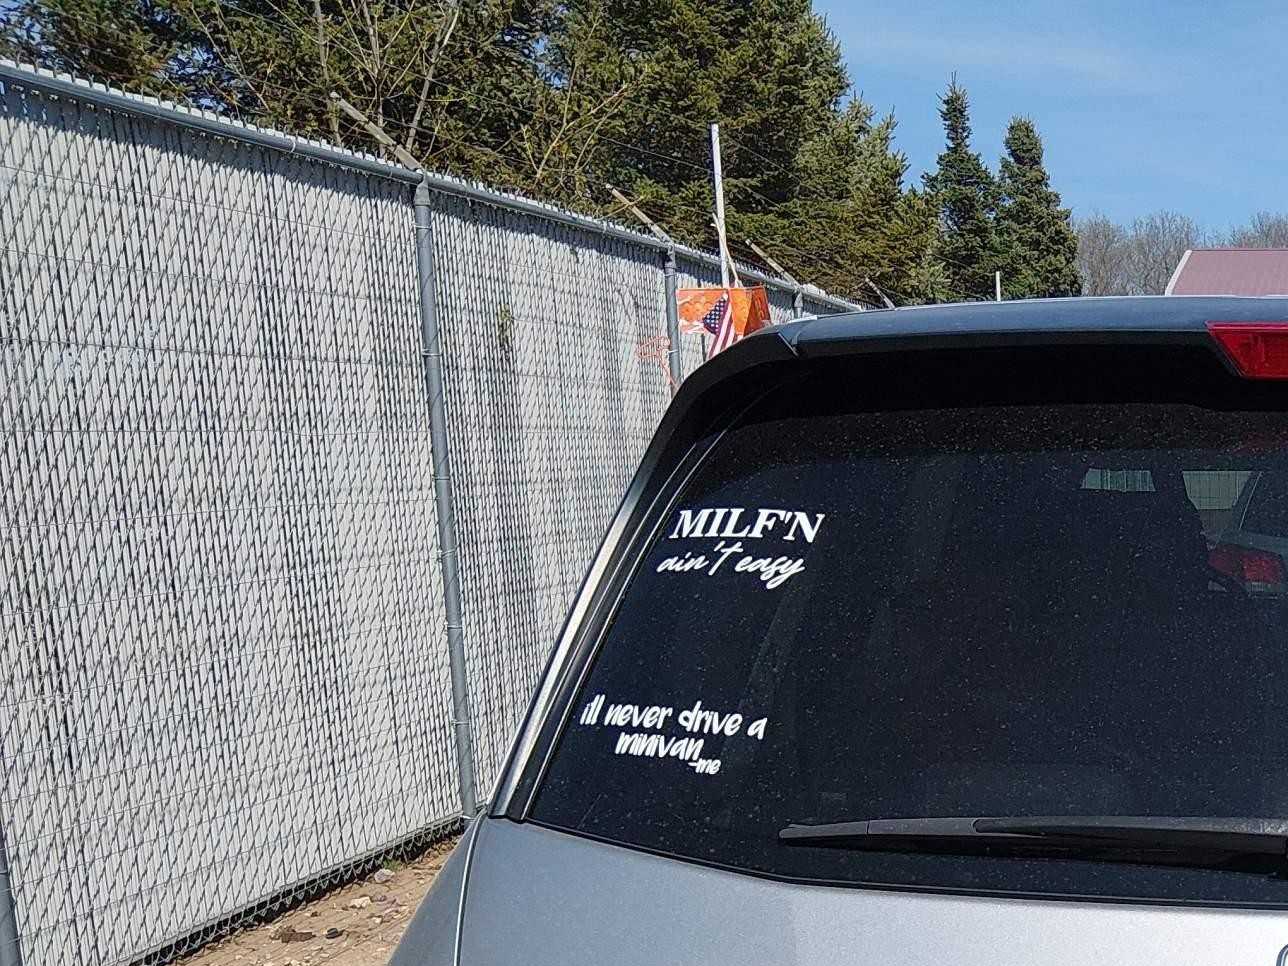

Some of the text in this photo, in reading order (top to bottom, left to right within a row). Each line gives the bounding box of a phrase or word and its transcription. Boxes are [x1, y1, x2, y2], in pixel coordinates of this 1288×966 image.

[669, 507, 825, 543] MILF'N
[656, 541, 805, 590] ain't easy
[603, 703, 673, 730] never
[677, 700, 743, 737] drive
[746, 717, 768, 740] a
[614, 732, 705, 761] minivan
